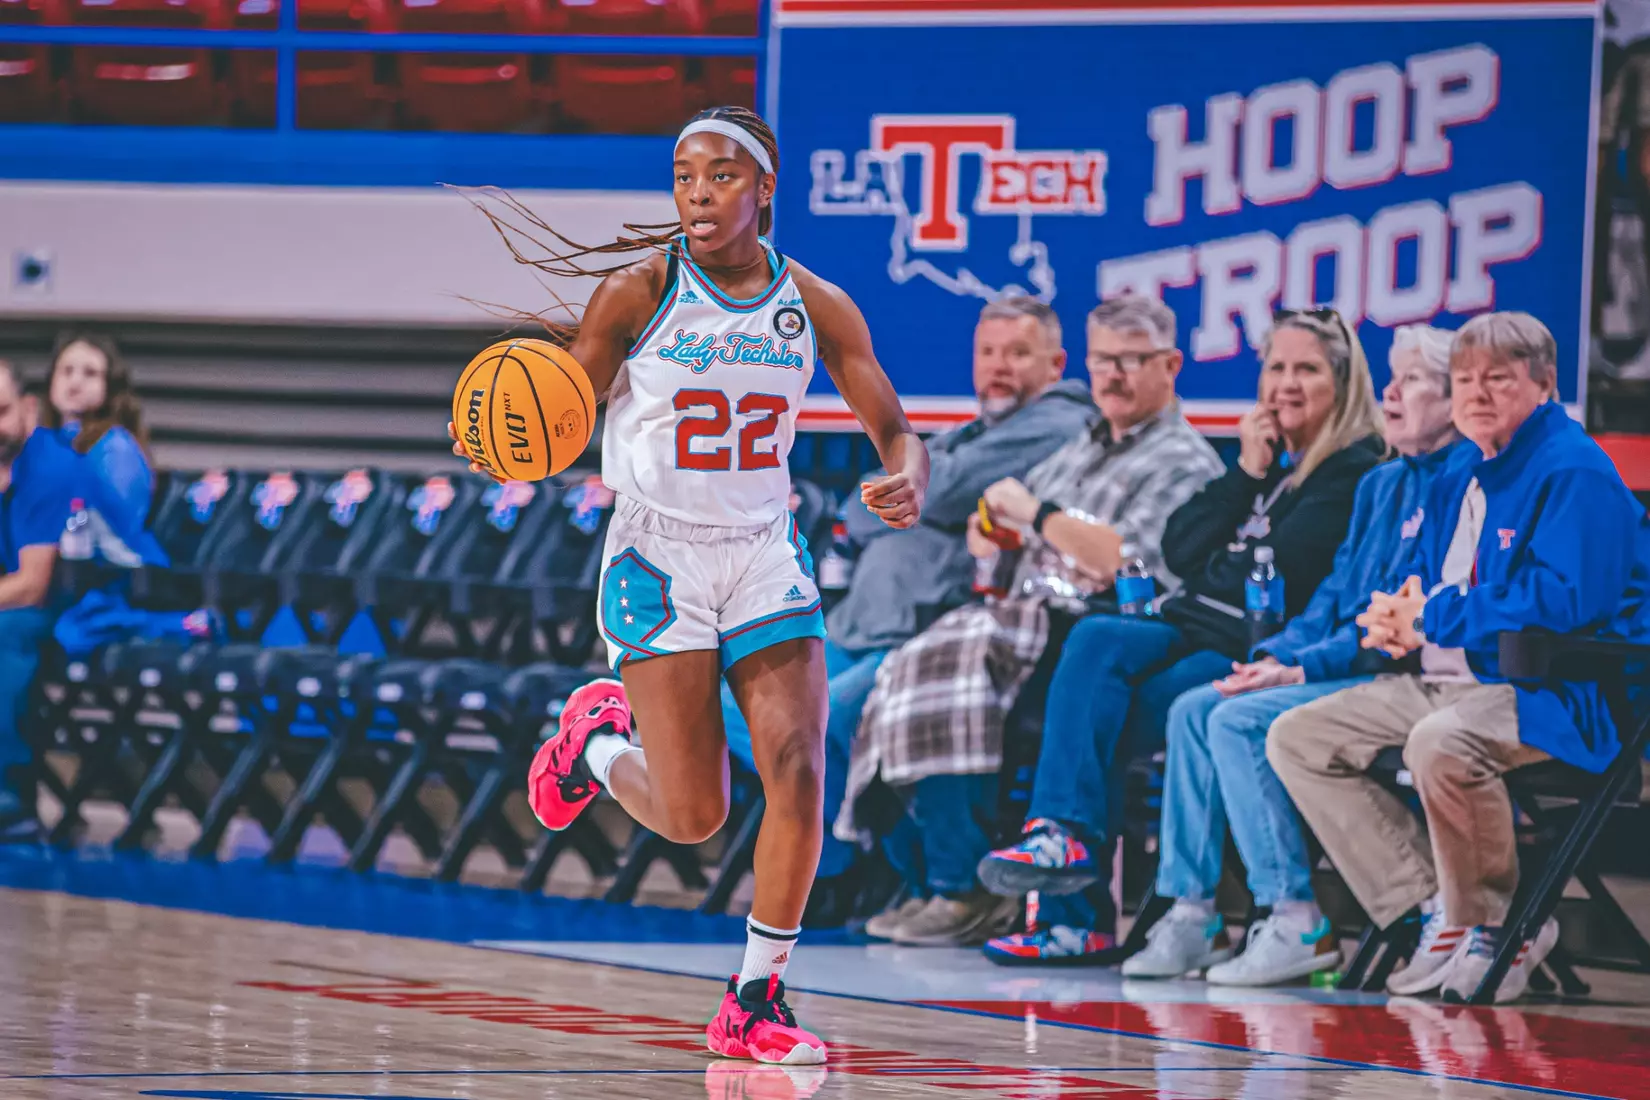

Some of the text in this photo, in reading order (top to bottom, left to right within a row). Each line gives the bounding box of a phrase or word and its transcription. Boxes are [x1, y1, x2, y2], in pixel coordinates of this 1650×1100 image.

[1144, 42, 1499, 227] HOOP
[809, 150, 905, 216] LA
[656, 328, 718, 375] Lady
[503, 391, 511, 411] NXT
[671, 387, 790, 472] 22
[505, 411, 533, 463] EVO
